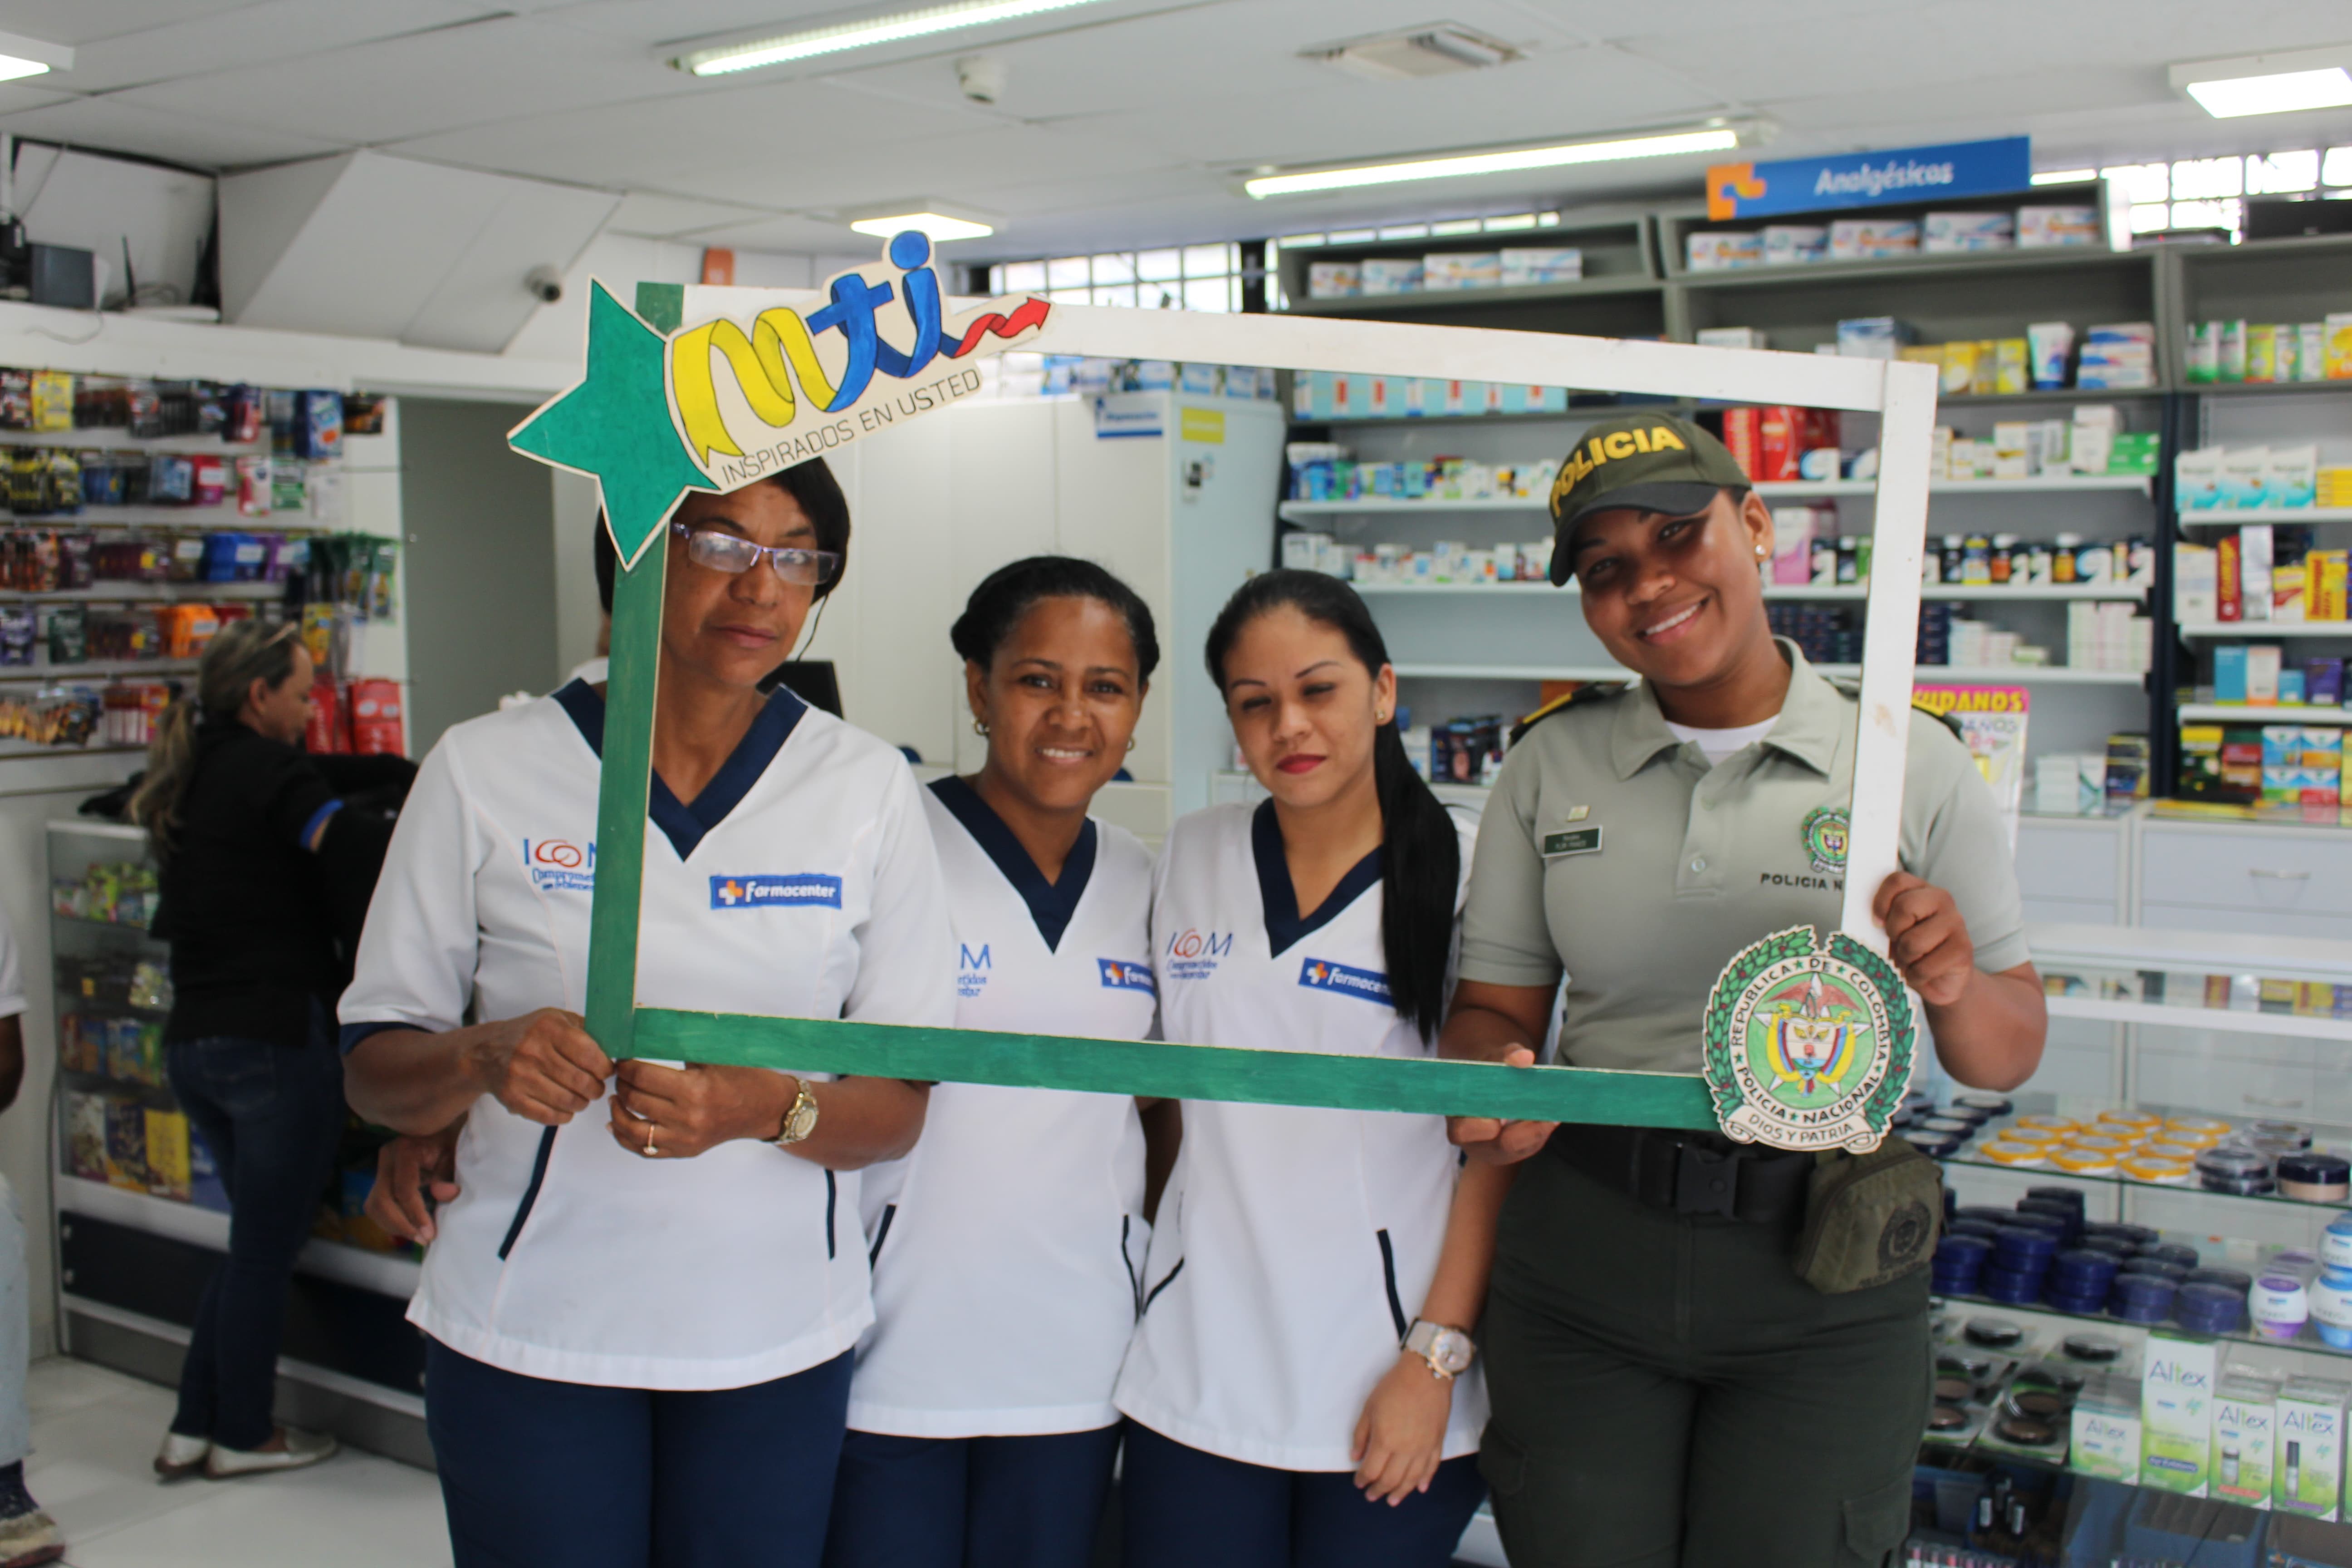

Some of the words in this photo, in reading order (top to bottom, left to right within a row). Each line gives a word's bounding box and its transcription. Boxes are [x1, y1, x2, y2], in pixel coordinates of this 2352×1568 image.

[1814, 159, 1954, 196] Analgésicos
[722, 419, 854, 485] INSPIRADOS
[859, 403, 892, 431] EN
[897, 368, 980, 416] USTED
[1550, 426, 1686, 518] POLICIA
[1760, 873, 1828, 890] POLICIA
[1730, 965, 1790, 1046] REPUBLICA
[1809, 958, 1832, 973] DE
[1850, 972, 1888, 1061] COLOMBIA
[1737, 1067, 1786, 1119] POLICIA
[1803, 1076, 1879, 1123] NACIONAL
[1748, 1114, 1784, 1140] DIOS
[1787, 1131, 1797, 1141] Y
[1800, 1123, 1853, 1142] PATRIA
